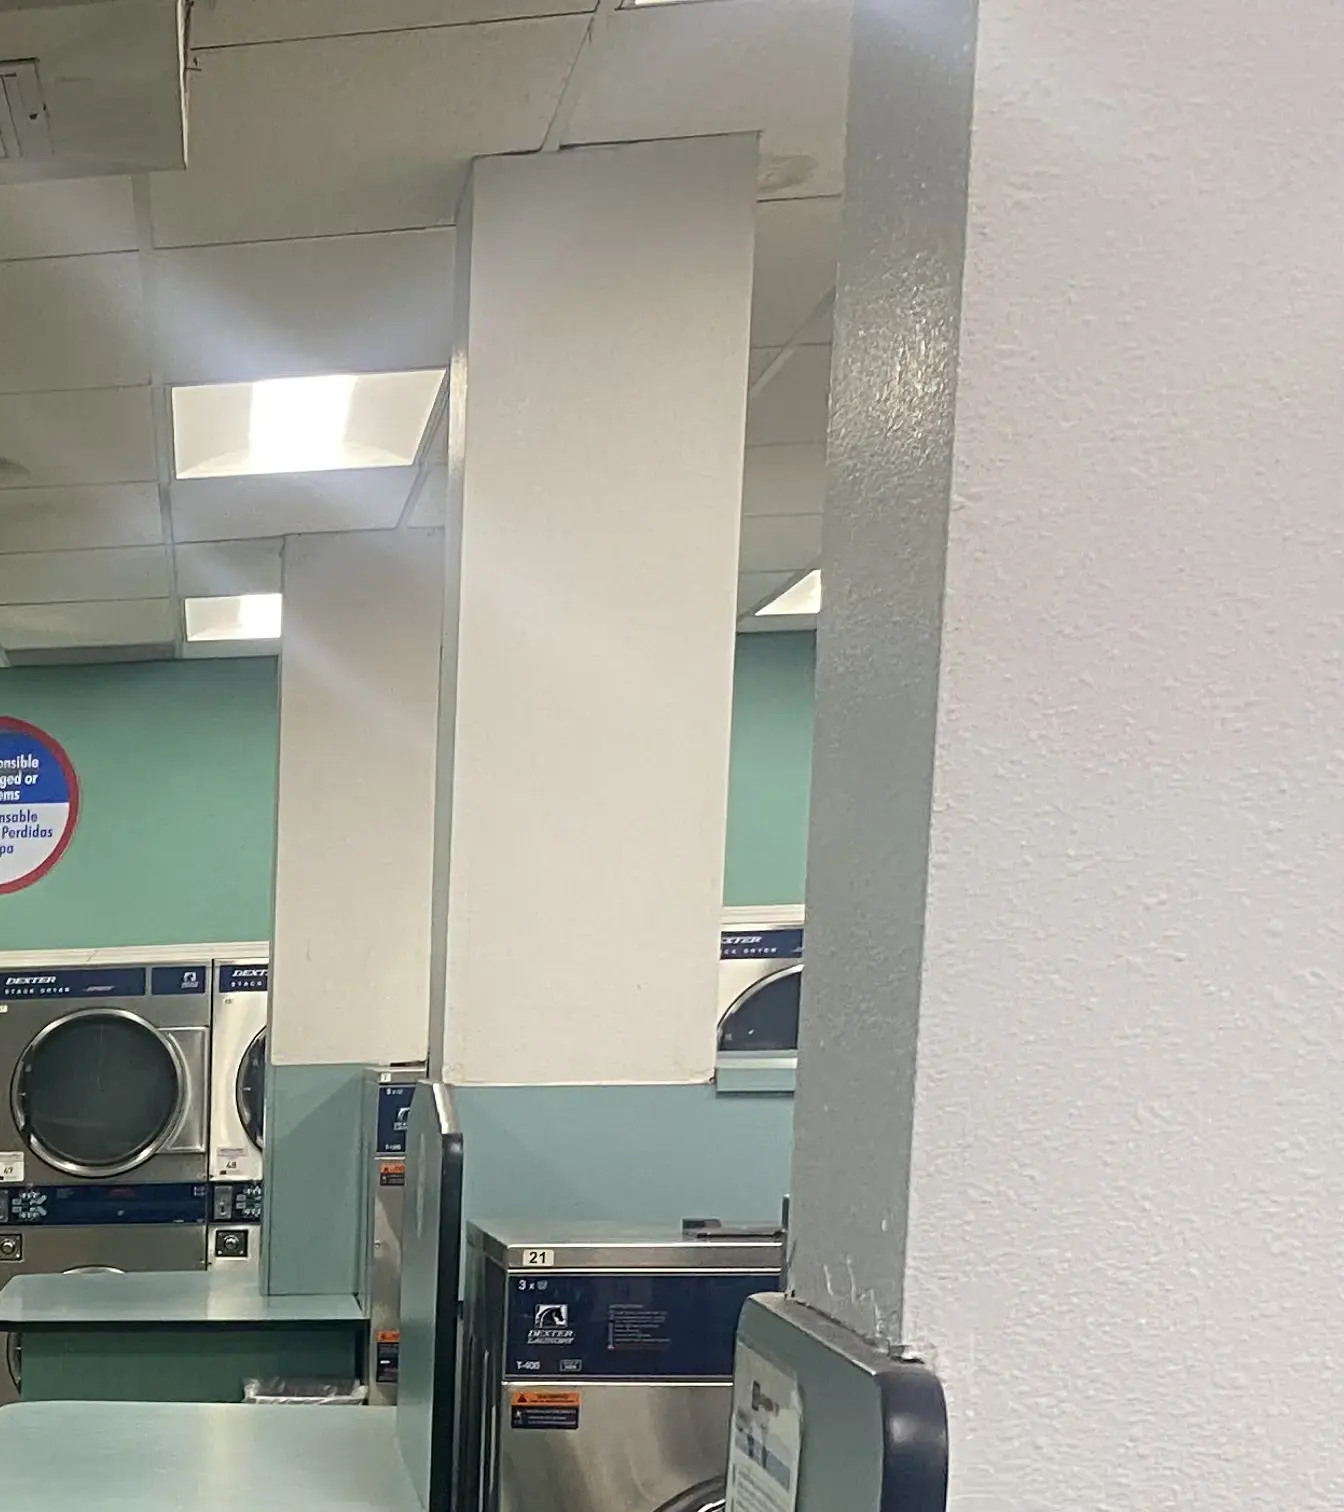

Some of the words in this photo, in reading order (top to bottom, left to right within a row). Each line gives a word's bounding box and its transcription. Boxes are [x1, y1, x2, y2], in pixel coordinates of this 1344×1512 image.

[24, 774, 38, 784] or
[2, 824, 53, 838] Perdidas
[722, 936, 762, 944] XTER
[232, 969, 268, 977] DEXT
[5, 976, 56, 985] DEXTER
[529, 1251, 547, 1264] 21
[518, 1280, 526, 1290] 3
